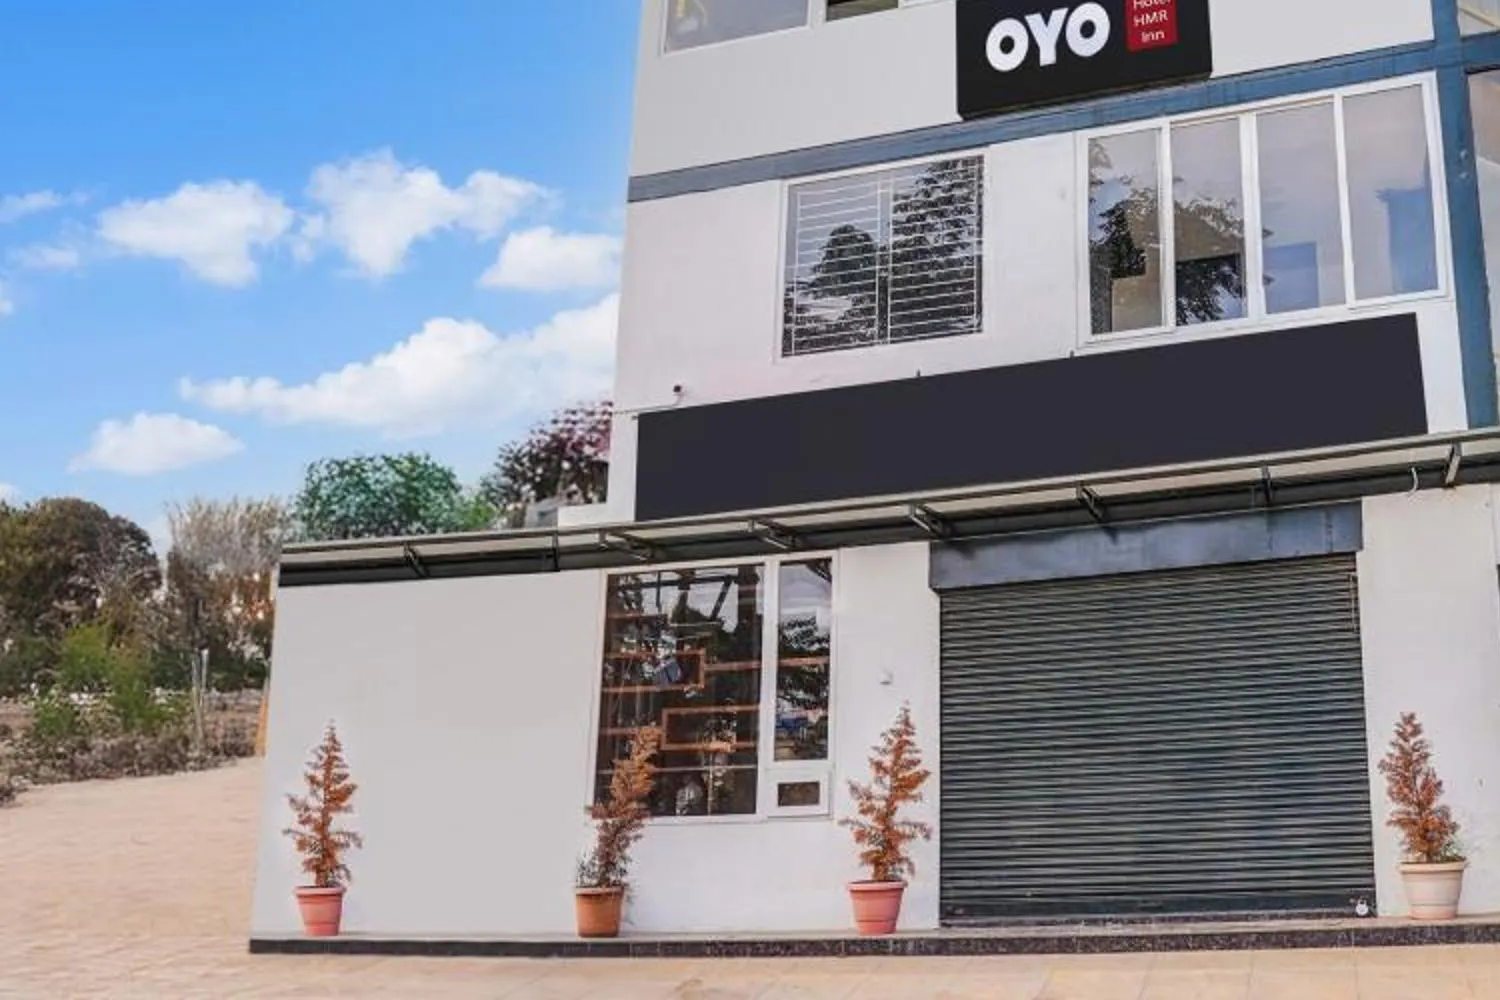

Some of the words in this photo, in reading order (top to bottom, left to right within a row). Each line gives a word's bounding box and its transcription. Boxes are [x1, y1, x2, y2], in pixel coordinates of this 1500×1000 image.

[1133, 10, 1169, 27] HMR
[985, 1, 1111, 73] OYO
[1141, 29, 1166, 44] Inn
